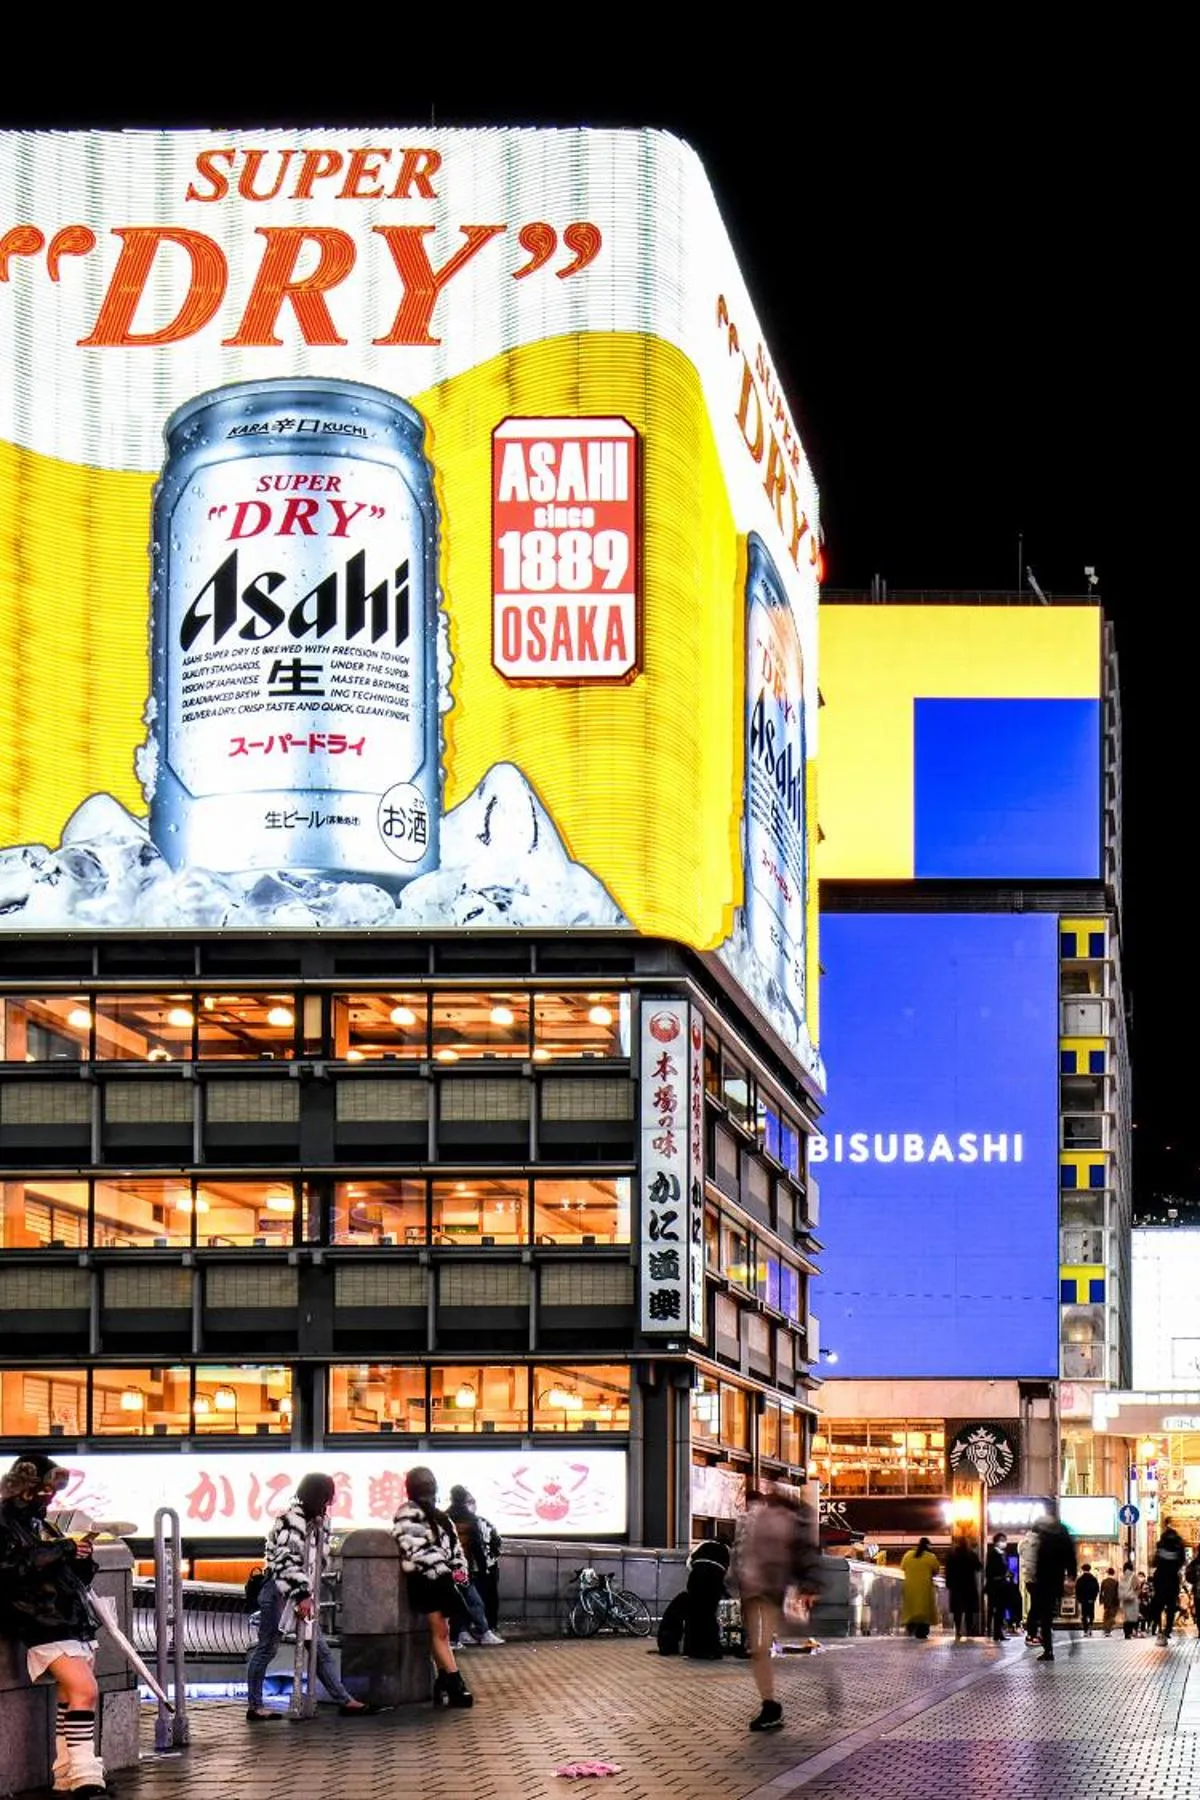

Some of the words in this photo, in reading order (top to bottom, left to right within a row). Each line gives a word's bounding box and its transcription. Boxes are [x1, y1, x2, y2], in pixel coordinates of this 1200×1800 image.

[186, 148, 442, 202] SUPER
[228, 422, 269, 436] KARA
[272, 418, 320, 433] 辛口
[322, 421, 367, 436] KUCHI
[498, 441, 628, 502] ASAHI
[256, 474, 342, 492] SUPER
[533, 503, 595, 529] since
[498, 530, 629, 592] 1889
[180, 548, 410, 652] Asahi
[502, 605, 627, 662] OSAKA
[262, 645, 302, 655] BREWED
[305, 644, 330, 654] WITH
[267, 656, 325, 697] 生
[330, 660, 364, 670] UNDER
[366, 663, 383, 674] THE
[330, 674, 371, 685] MASTER
[330, 689, 350, 698] ING
[296, 701, 320, 711] AND
[228, 733, 366, 757] スーパードライ
[651, 1051, 679, 1160] 本場の味
